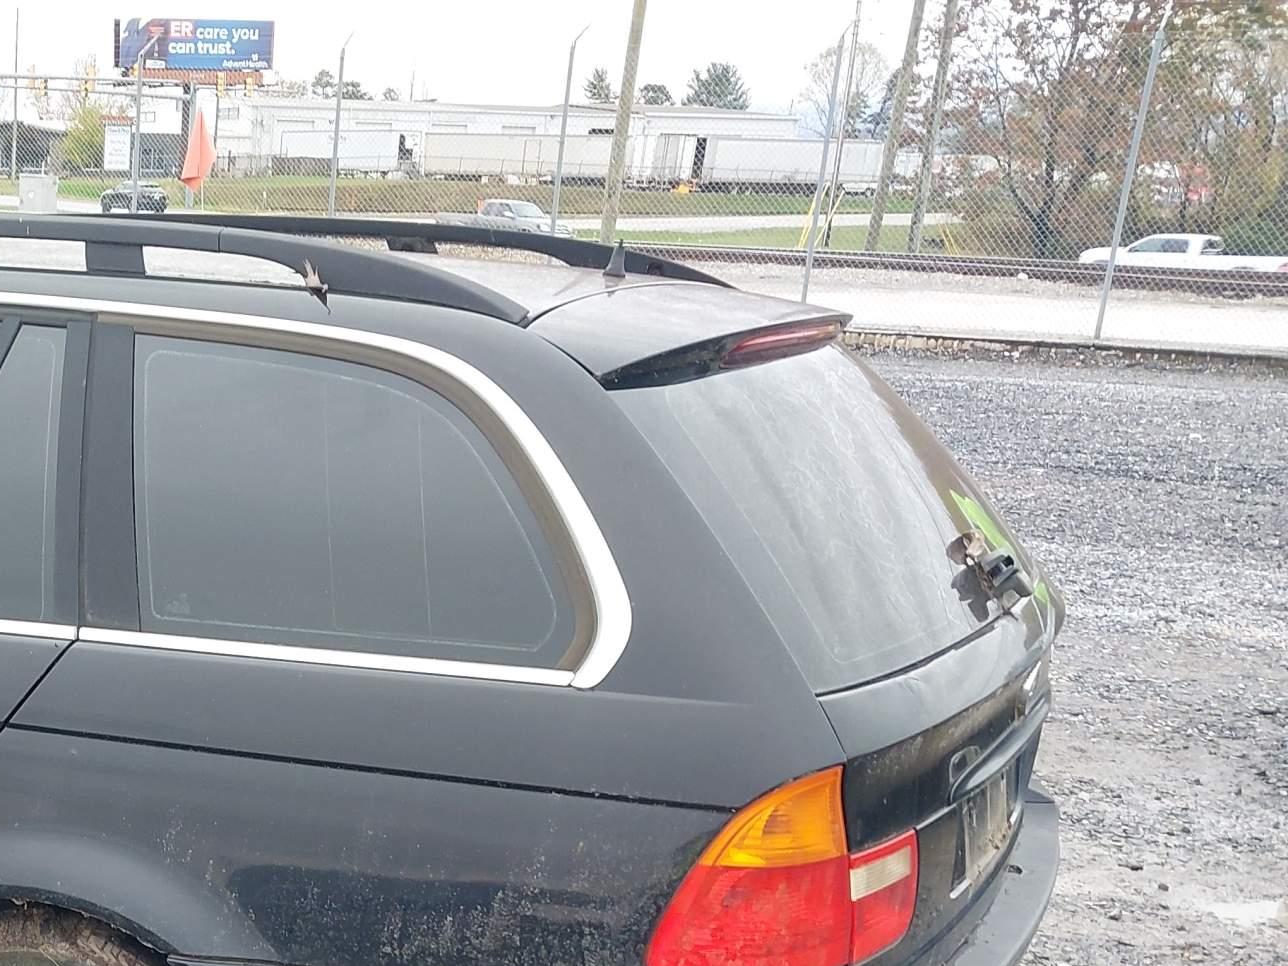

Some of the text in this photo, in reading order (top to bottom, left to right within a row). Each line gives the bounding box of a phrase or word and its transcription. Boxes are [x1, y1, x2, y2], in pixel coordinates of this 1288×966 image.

[170, 21, 259, 43] ER care you
[168, 41, 235, 55] can trust.
